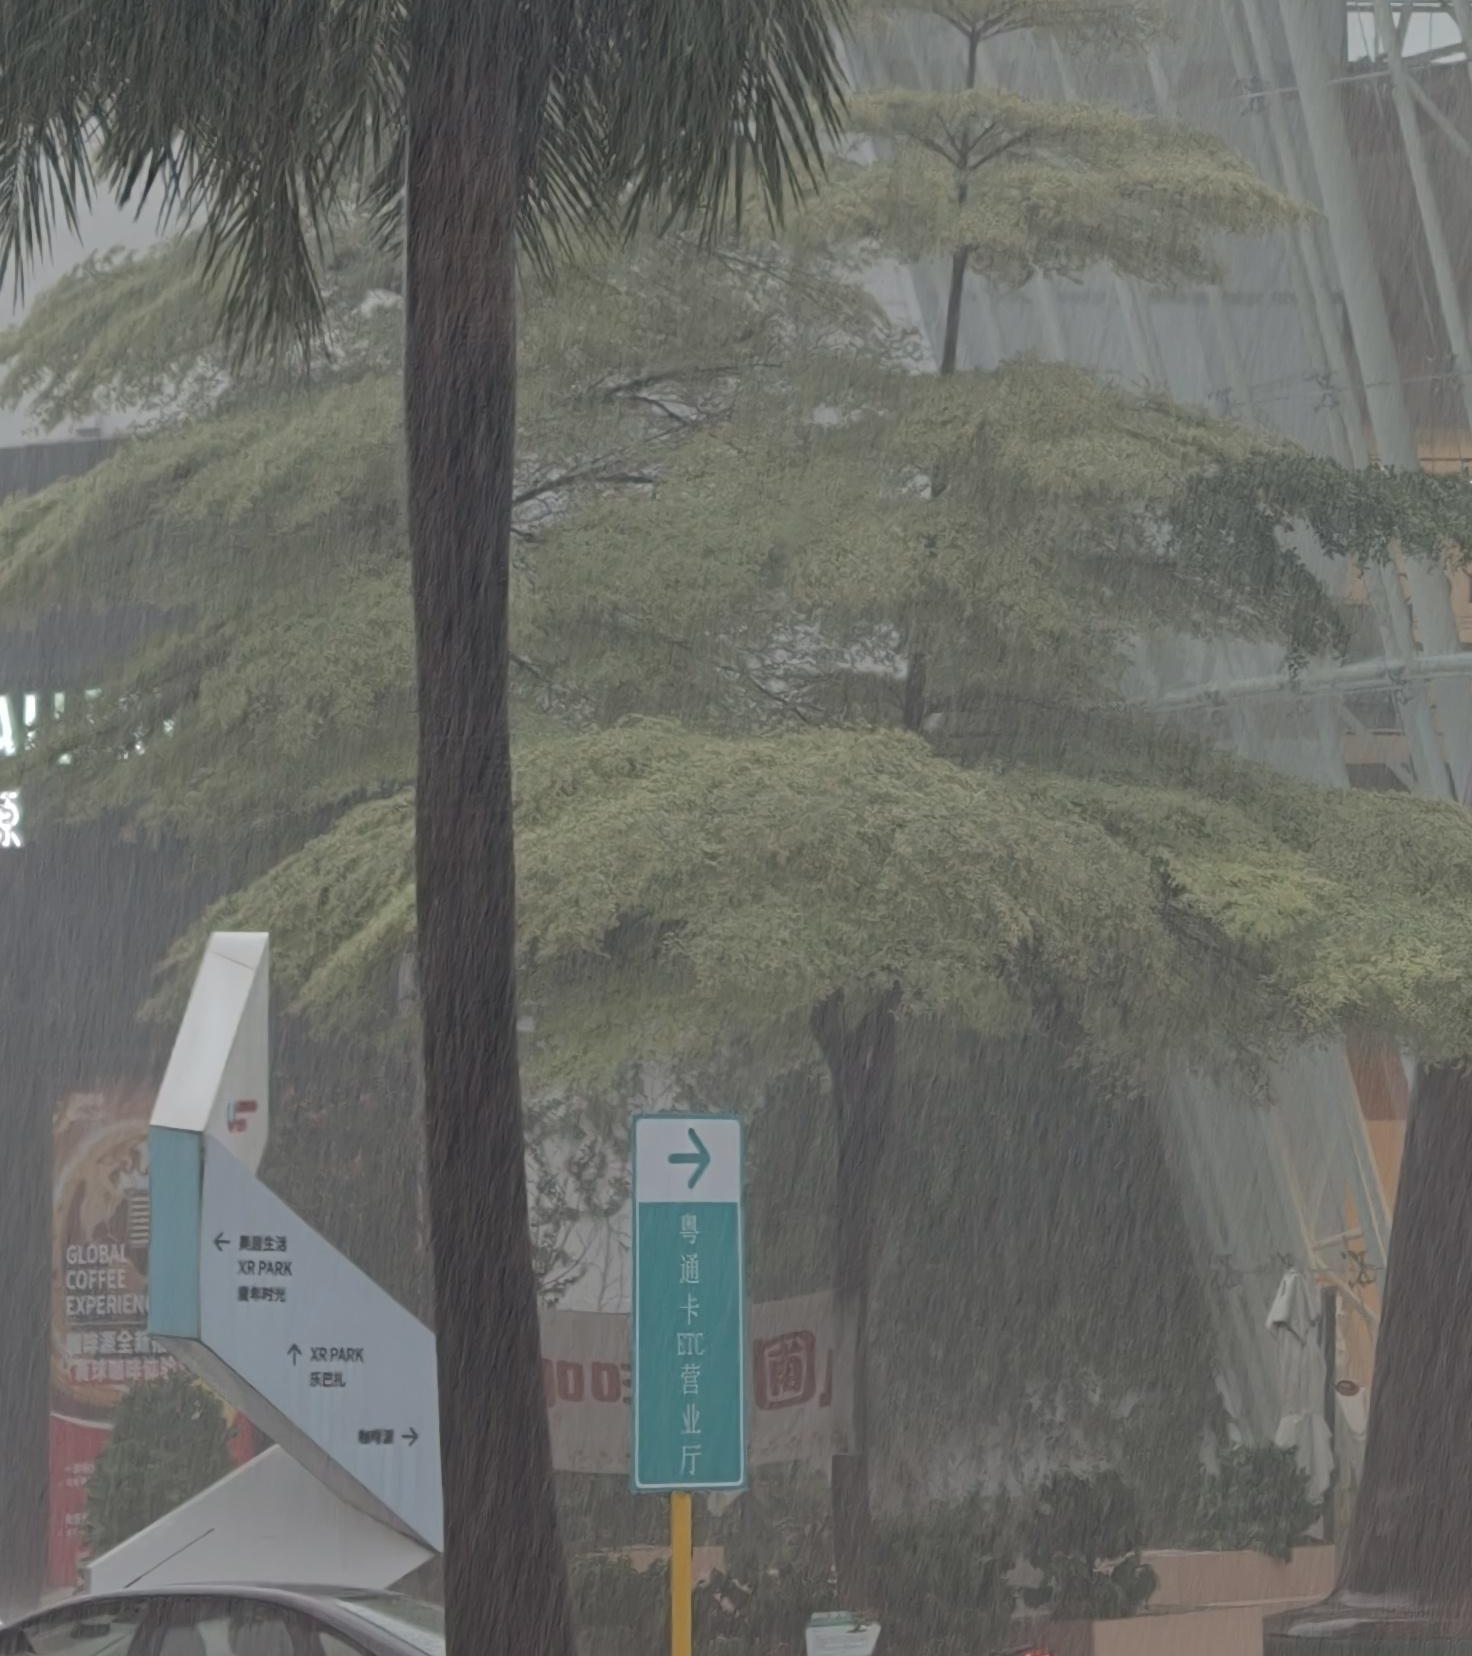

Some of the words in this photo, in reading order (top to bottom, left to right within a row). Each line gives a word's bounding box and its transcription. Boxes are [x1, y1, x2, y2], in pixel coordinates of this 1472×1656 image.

[66, 1243, 128, 1266] GLOBAL
[258, 1260, 292, 1276] PARK
[66, 1269, 127, 1290] COFFEE
[65, 1294, 149, 1316] EXPERIEN
[330, 1347, 365, 1363] PARK
[676, 1212, 705, 1477] 粤通卡ETC营业厅
